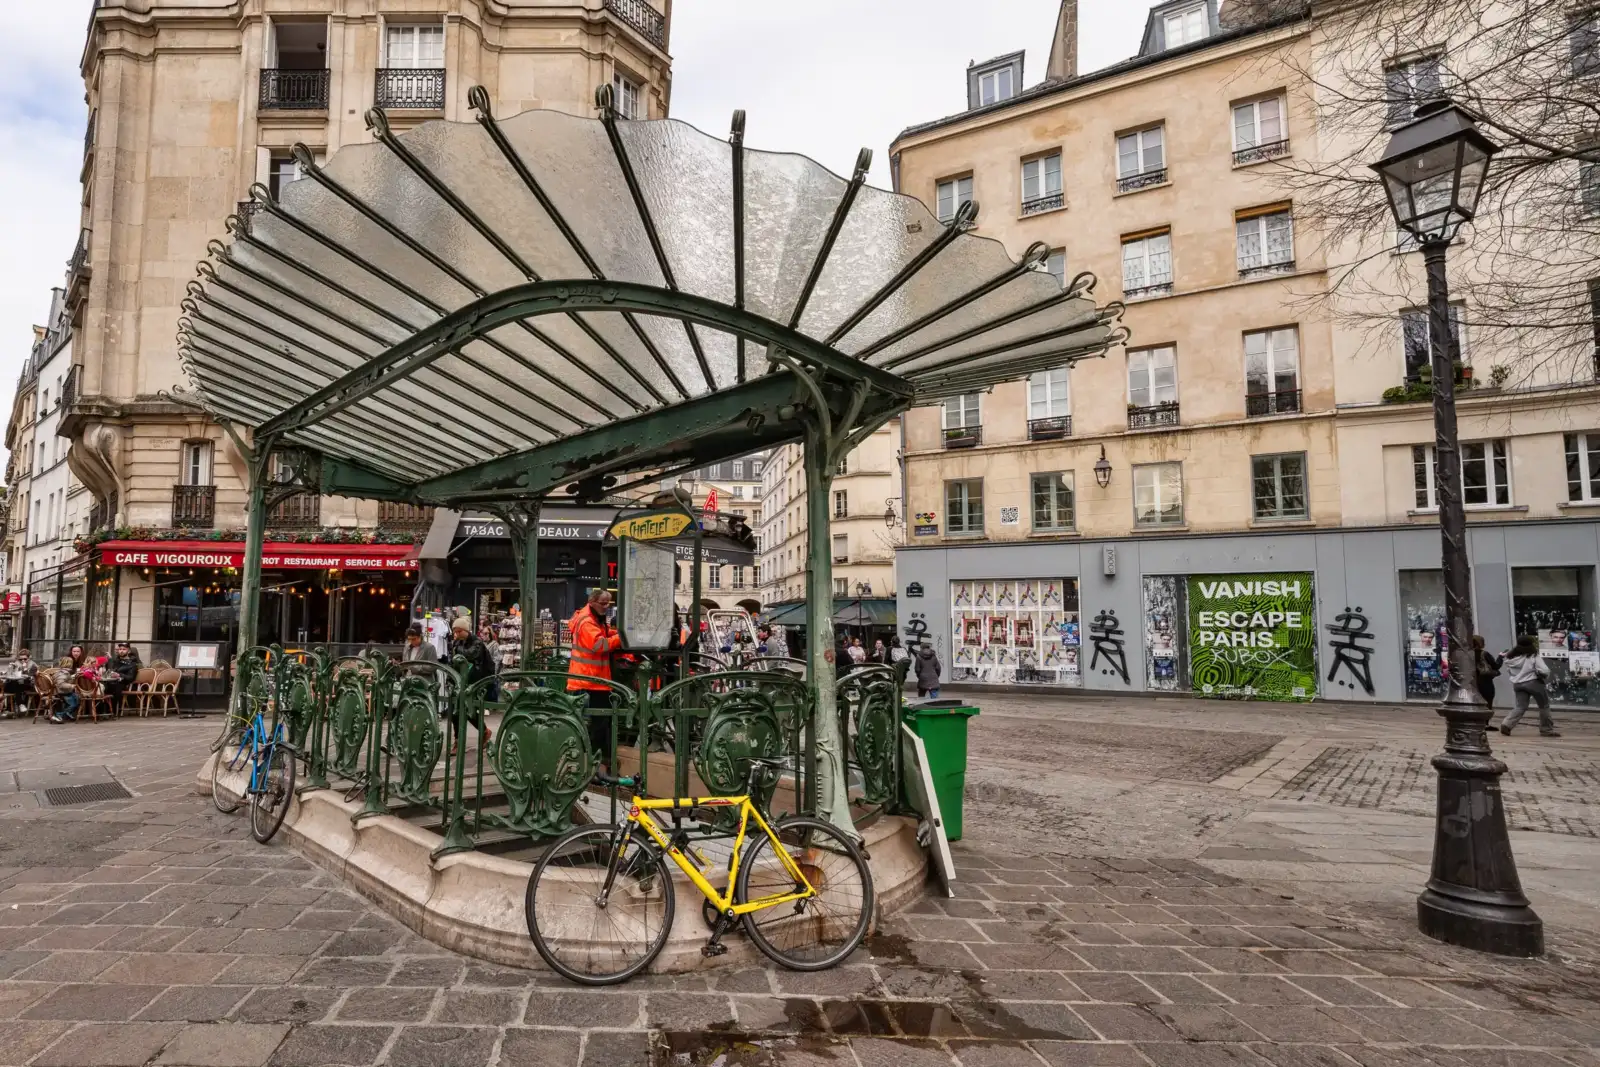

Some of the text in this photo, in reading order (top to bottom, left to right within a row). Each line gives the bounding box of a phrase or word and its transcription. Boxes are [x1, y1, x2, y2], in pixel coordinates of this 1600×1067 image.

[464, 525, 580, 538] TABAC DEAUX
[630, 517, 670, 538] CHATELET
[115, 553, 232, 565] CAFE VIGOUROUX
[284, 557, 340, 566] RESTAURANT
[345, 558, 382, 567] SERVICE
[386, 559, 406, 567] NON
[1198, 580, 1301, 599] VANISH
[1199, 611, 1302, 628] ESCAPE
[1200, 631, 1281, 648] PARIS.
